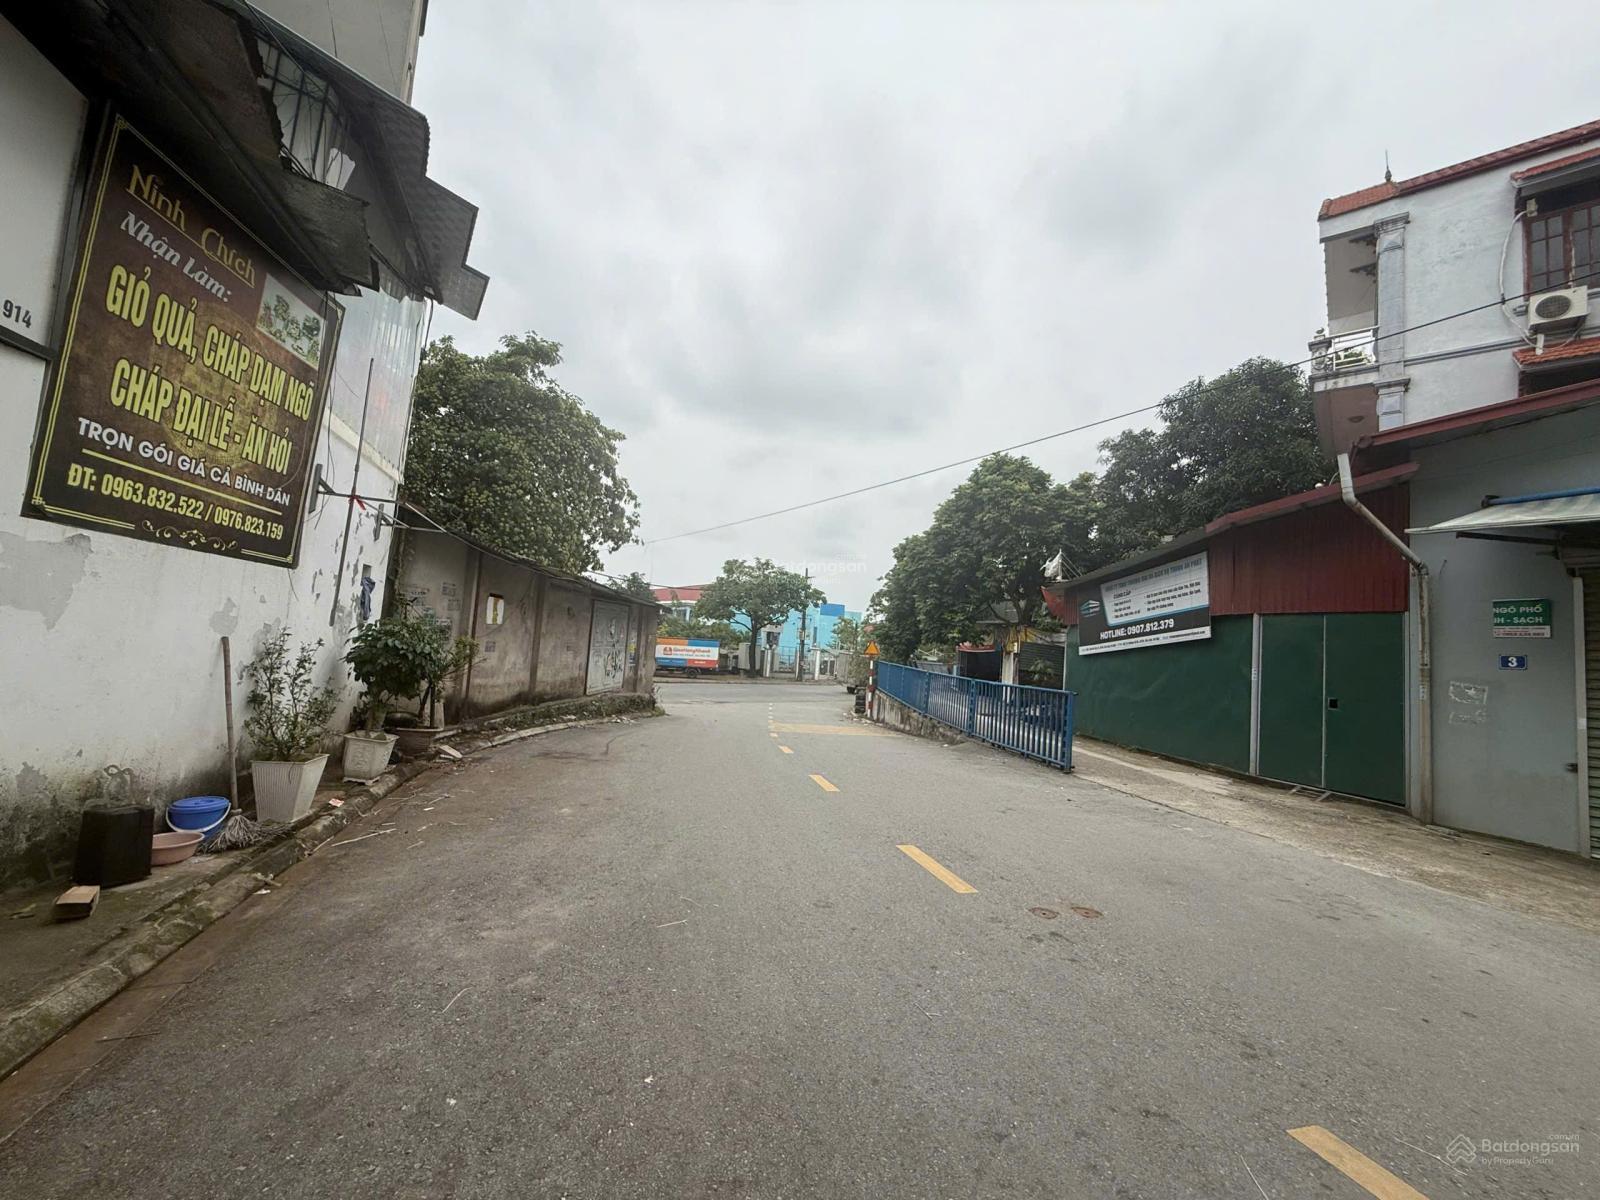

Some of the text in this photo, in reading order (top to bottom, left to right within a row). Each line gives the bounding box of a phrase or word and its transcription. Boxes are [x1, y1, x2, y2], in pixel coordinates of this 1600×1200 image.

[120, 211, 232, 303] Nhận Làm:
[3, 299, 32, 329] 914
[106, 264, 315, 422] GIỎ QUẢ, CHÁP DẠM NGÕ
[110, 357, 175, 423] CHÁP
[172, 386, 212, 448] ĐẠI
[208, 396, 237, 451] LỄ
[241, 414, 269, 465] ĂN
[266, 427, 293, 475] HỎI
[78, 416, 291, 506] TRỌN GÓI GIÁ CẢ BÌNH DÂN
[67, 462, 284, 541] ĐT: 0963.832.522 / 0976.823.159
[1100, 628, 1127, 640] HOTLINE:
[1513, 616, 1543, 624] SẠCH
[1520, 603, 1543, 612] PHỐ
[1508, 656, 1518, 667] 3
